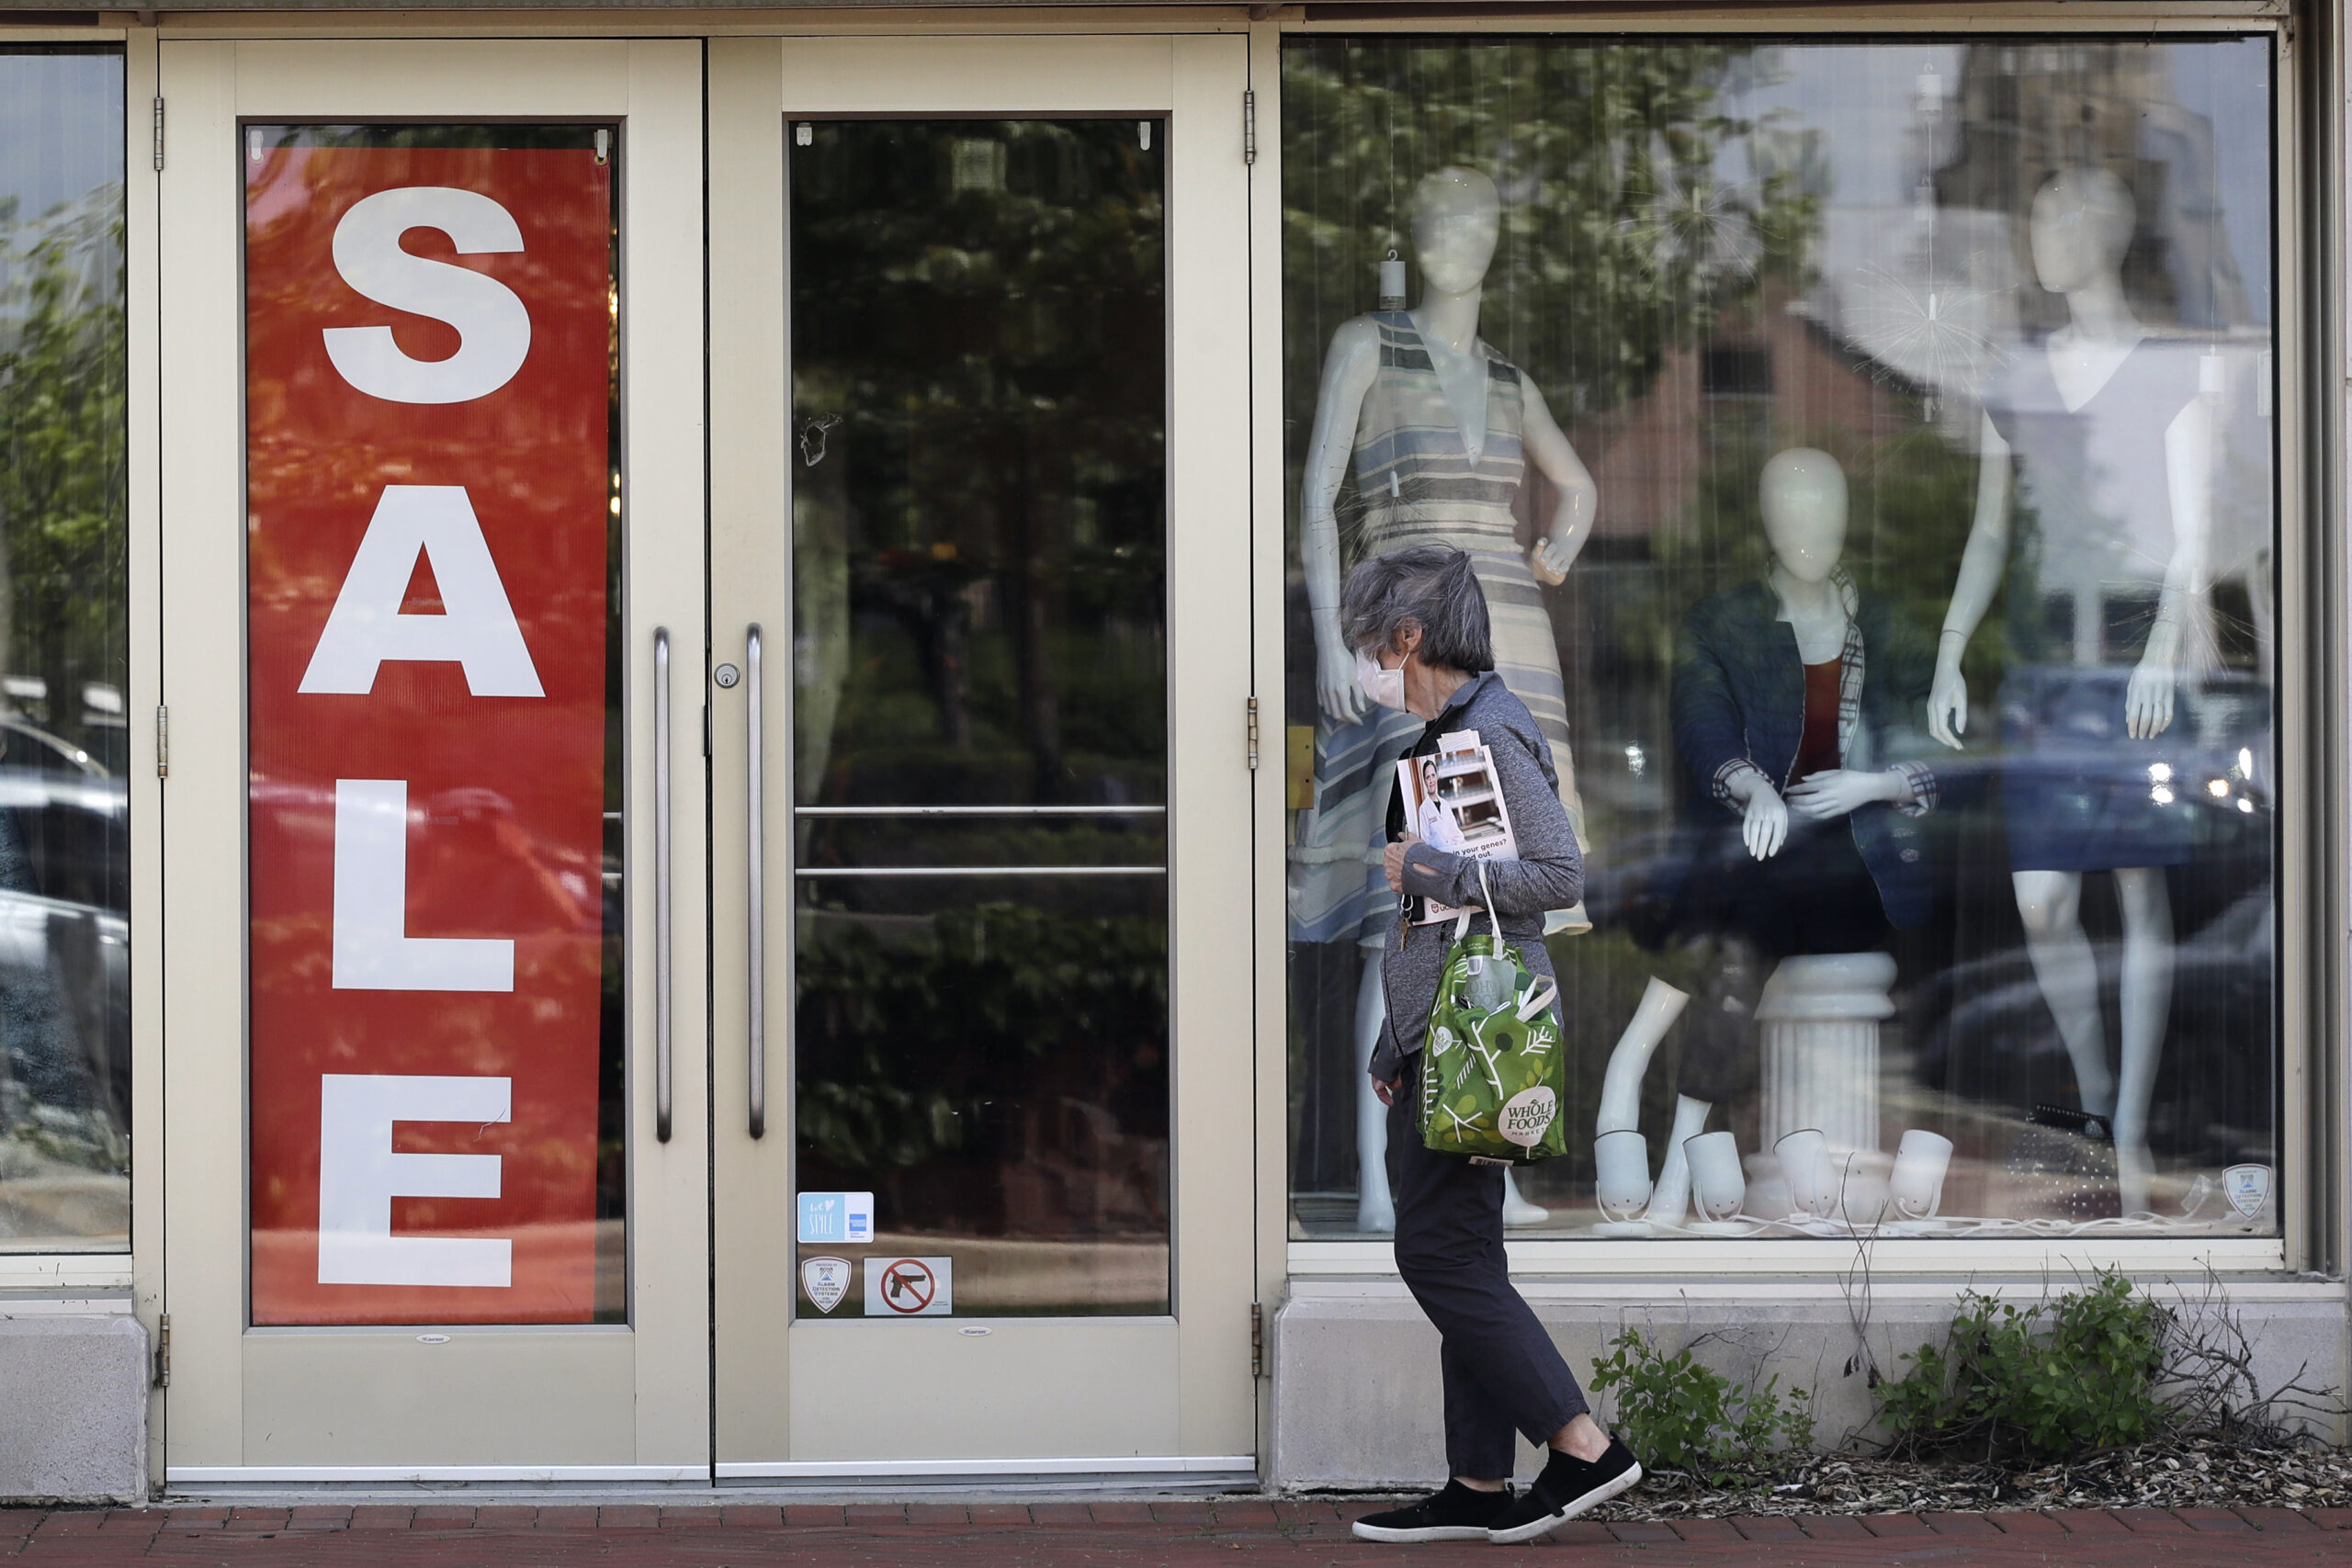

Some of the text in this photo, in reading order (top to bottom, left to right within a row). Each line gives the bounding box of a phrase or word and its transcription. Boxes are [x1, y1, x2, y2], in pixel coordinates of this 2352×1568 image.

[298, 187, 545, 1289] SALE
[1462, 847, 1479, 855] your
[1480, 839, 1507, 850] genes?
[1478, 851, 1493, 859] out.
[1508, 1100, 1554, 1118] WHOLE
[1507, 1112, 1551, 1130] FOODS
[1511, 1128, 1544, 1136] MARKET
[809, 1213, 833, 1235] STYLE
